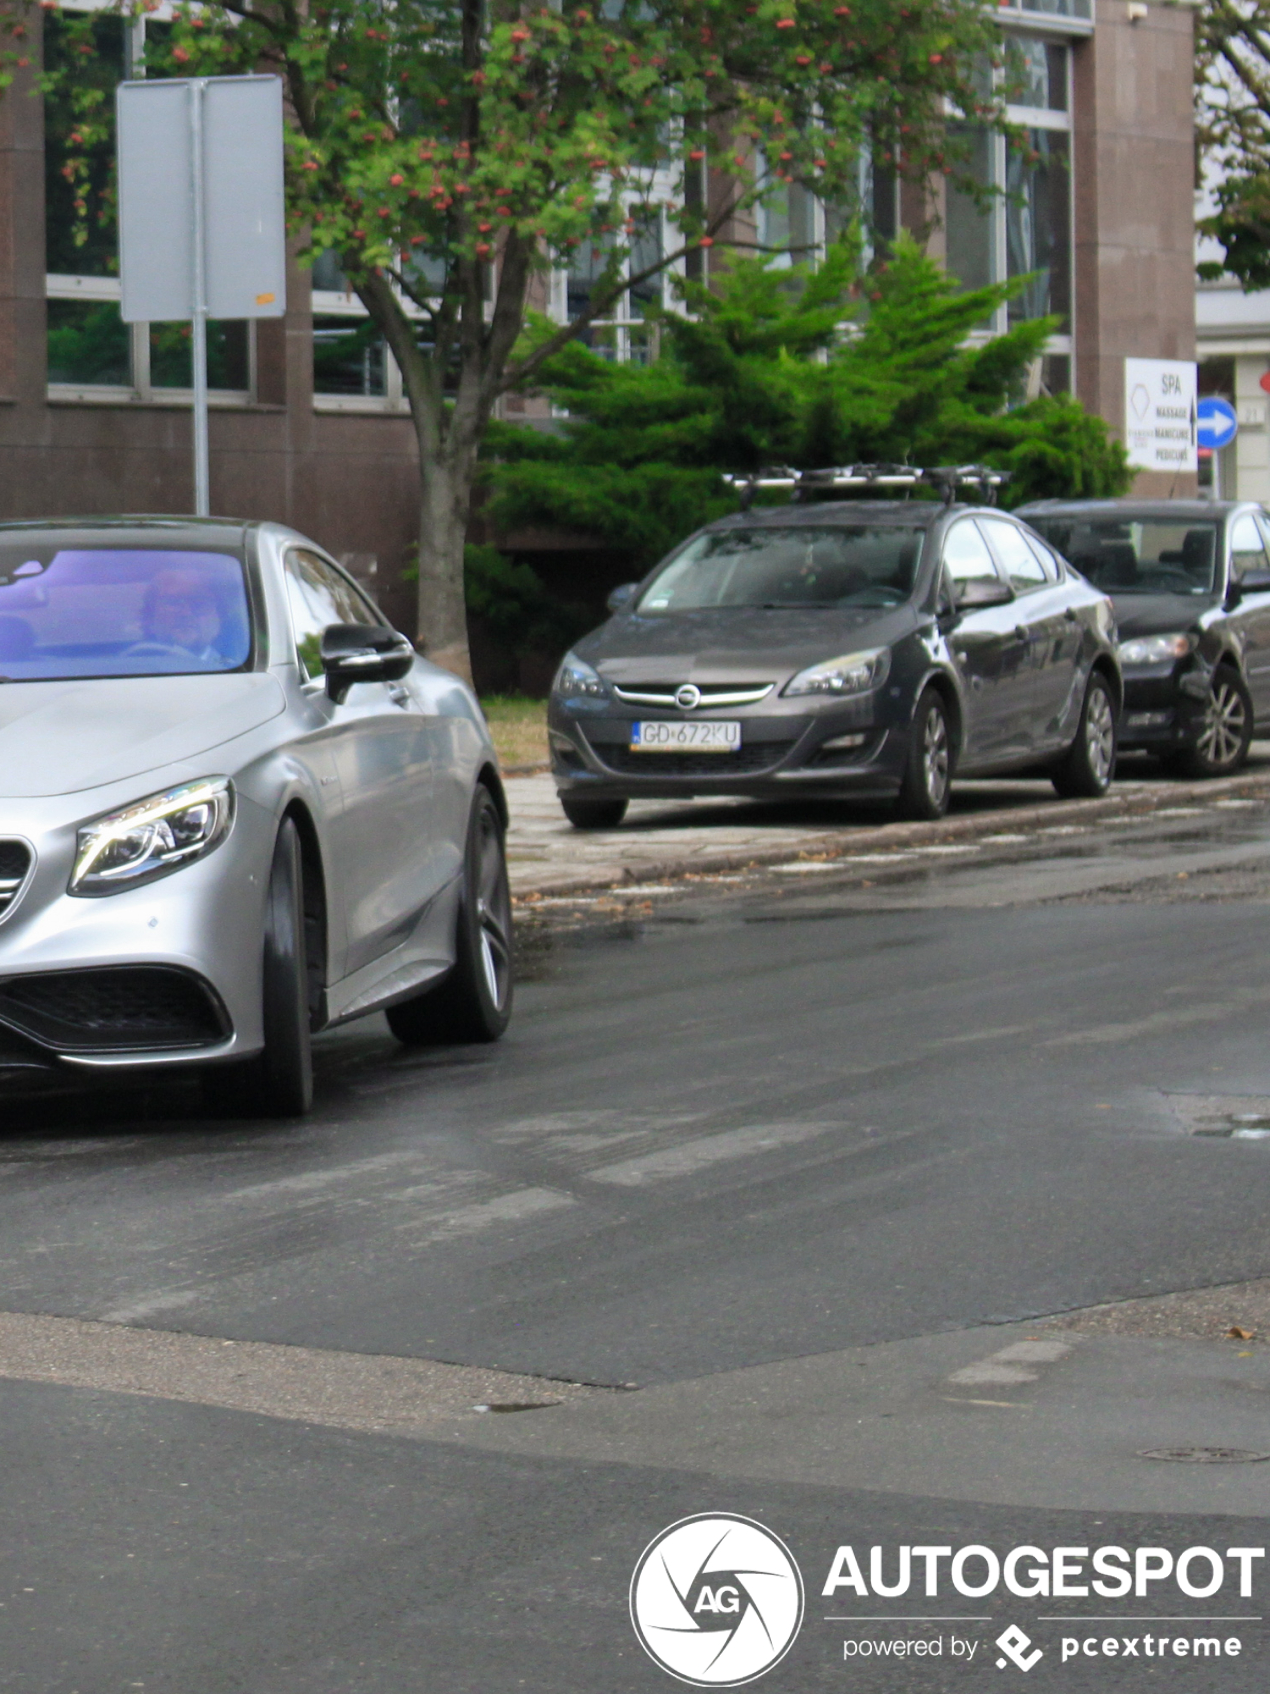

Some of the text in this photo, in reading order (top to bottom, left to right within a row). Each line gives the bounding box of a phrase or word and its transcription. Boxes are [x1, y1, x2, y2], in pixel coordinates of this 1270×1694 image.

[1161, 374, 1181, 395] SPA
[1156, 407, 1187, 419] MASSAGE
[1155, 427, 1189, 440] MANICURE
[644, 723, 737, 743] GD 672KU
